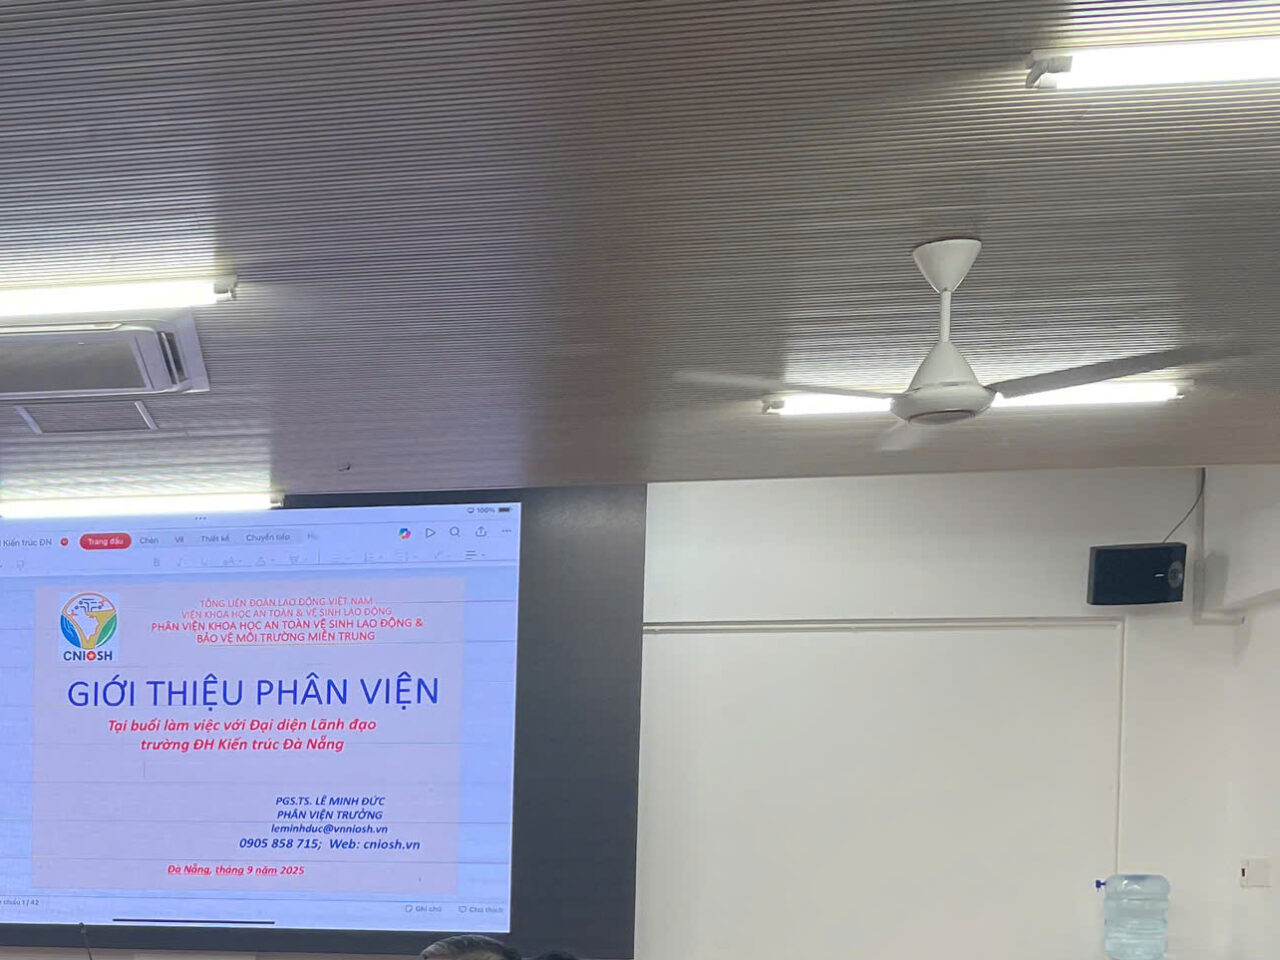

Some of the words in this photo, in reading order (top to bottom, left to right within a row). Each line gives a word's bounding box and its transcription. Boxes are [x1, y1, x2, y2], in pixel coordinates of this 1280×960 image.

[88, 538, 109, 547] Trang
[200, 597, 225, 608] TỔNG
[227, 597, 247, 608] LIÊN
[278, 598, 296, 607] LAO
[298, 596, 326, 608] ĐỘNG
[328, 595, 348, 606] VIỆT
[351, 597, 373, 605] NAM
[182, 608, 202, 619] VIỆN
[205, 610, 228, 619] KHOA
[231, 610, 251, 620] HỌC
[253, 610, 266, 618] AN
[270, 608, 294, 617] TOÀN
[296, 609, 303, 617] &
[320, 608, 341, 617] SINH
[344, 607, 362, 616] LAO
[364, 606, 392, 618] ĐỘNG
[151, 620, 179, 631] PHÂN
[182, 619, 205, 632] VIỆN
[208, 622, 237, 631] KHOA
[239, 621, 262, 631] HỌC
[264, 621, 279, 629] AN
[282, 619, 310, 629] TOÀN
[313, 618, 326, 631] VỆ
[329, 619, 354, 629] SINH
[357, 619, 378, 628] LAO
[380, 617, 412, 629] ĐỘNG
[415, 618, 424, 627] &
[197, 632, 218, 644] BẢO
[221, 631, 233, 644] VỆ
[236, 630, 258, 643] MÔI
[260, 630, 306, 642] TRƯỜNG
[308, 629, 336, 641] MIỀN
[338, 631, 375, 641] TRUNG
[63, 650, 113, 662] CNIOSH
[67, 674, 135, 707] GIỚI
[146, 673, 243, 712] THIỆU
[256, 671, 348, 705] PHÂN
[360, 670, 438, 711] VIỆN
[108, 719, 127, 734] Tại
[130, 717, 160, 732] buổi
[164, 718, 190, 732] làm
[193, 717, 220, 734] việc
[224, 717, 246, 731] với
[249, 718, 274, 734] Đại
[277, 717, 307, 733] diện
[311, 717, 345, 731] Lãnh
[348, 718, 377, 733] đạo
[140, 738, 190, 753] trường
[193, 739, 215, 750] ĐH
[218, 736, 248, 750] Kiến
[252, 737, 280, 751] trúc
[282, 738, 303, 750] Đà
[306, 735, 345, 753] Nẵng
[275, 796, 312, 806] PGS.TS.
[315, 795, 328, 806] LÊ
[329, 796, 359, 806] MINH
[361, 795, 386, 806] ĐỨC
[276, 808, 307, 820] PHÂN
[309, 808, 334, 822] VIỆN
[336, 807, 383, 820] TRƯỞNG
[271, 823, 388, 835] leminhduc@vnniosh.vn
[239, 838, 268, 849] 0905
[271, 838, 294, 849] 858
[296, 838, 322, 851] 715;
[329, 838, 361, 850] Web:
[363, 839, 420, 850] cniosh.vn
[167, 864, 182, 875] Đà
[183, 862, 212, 876] Nẵng,
[215, 864, 244, 876] tháng
[246, 865, 254, 875] 9
[255, 865, 278, 876] năm
[280, 866, 305, 875] 2025
